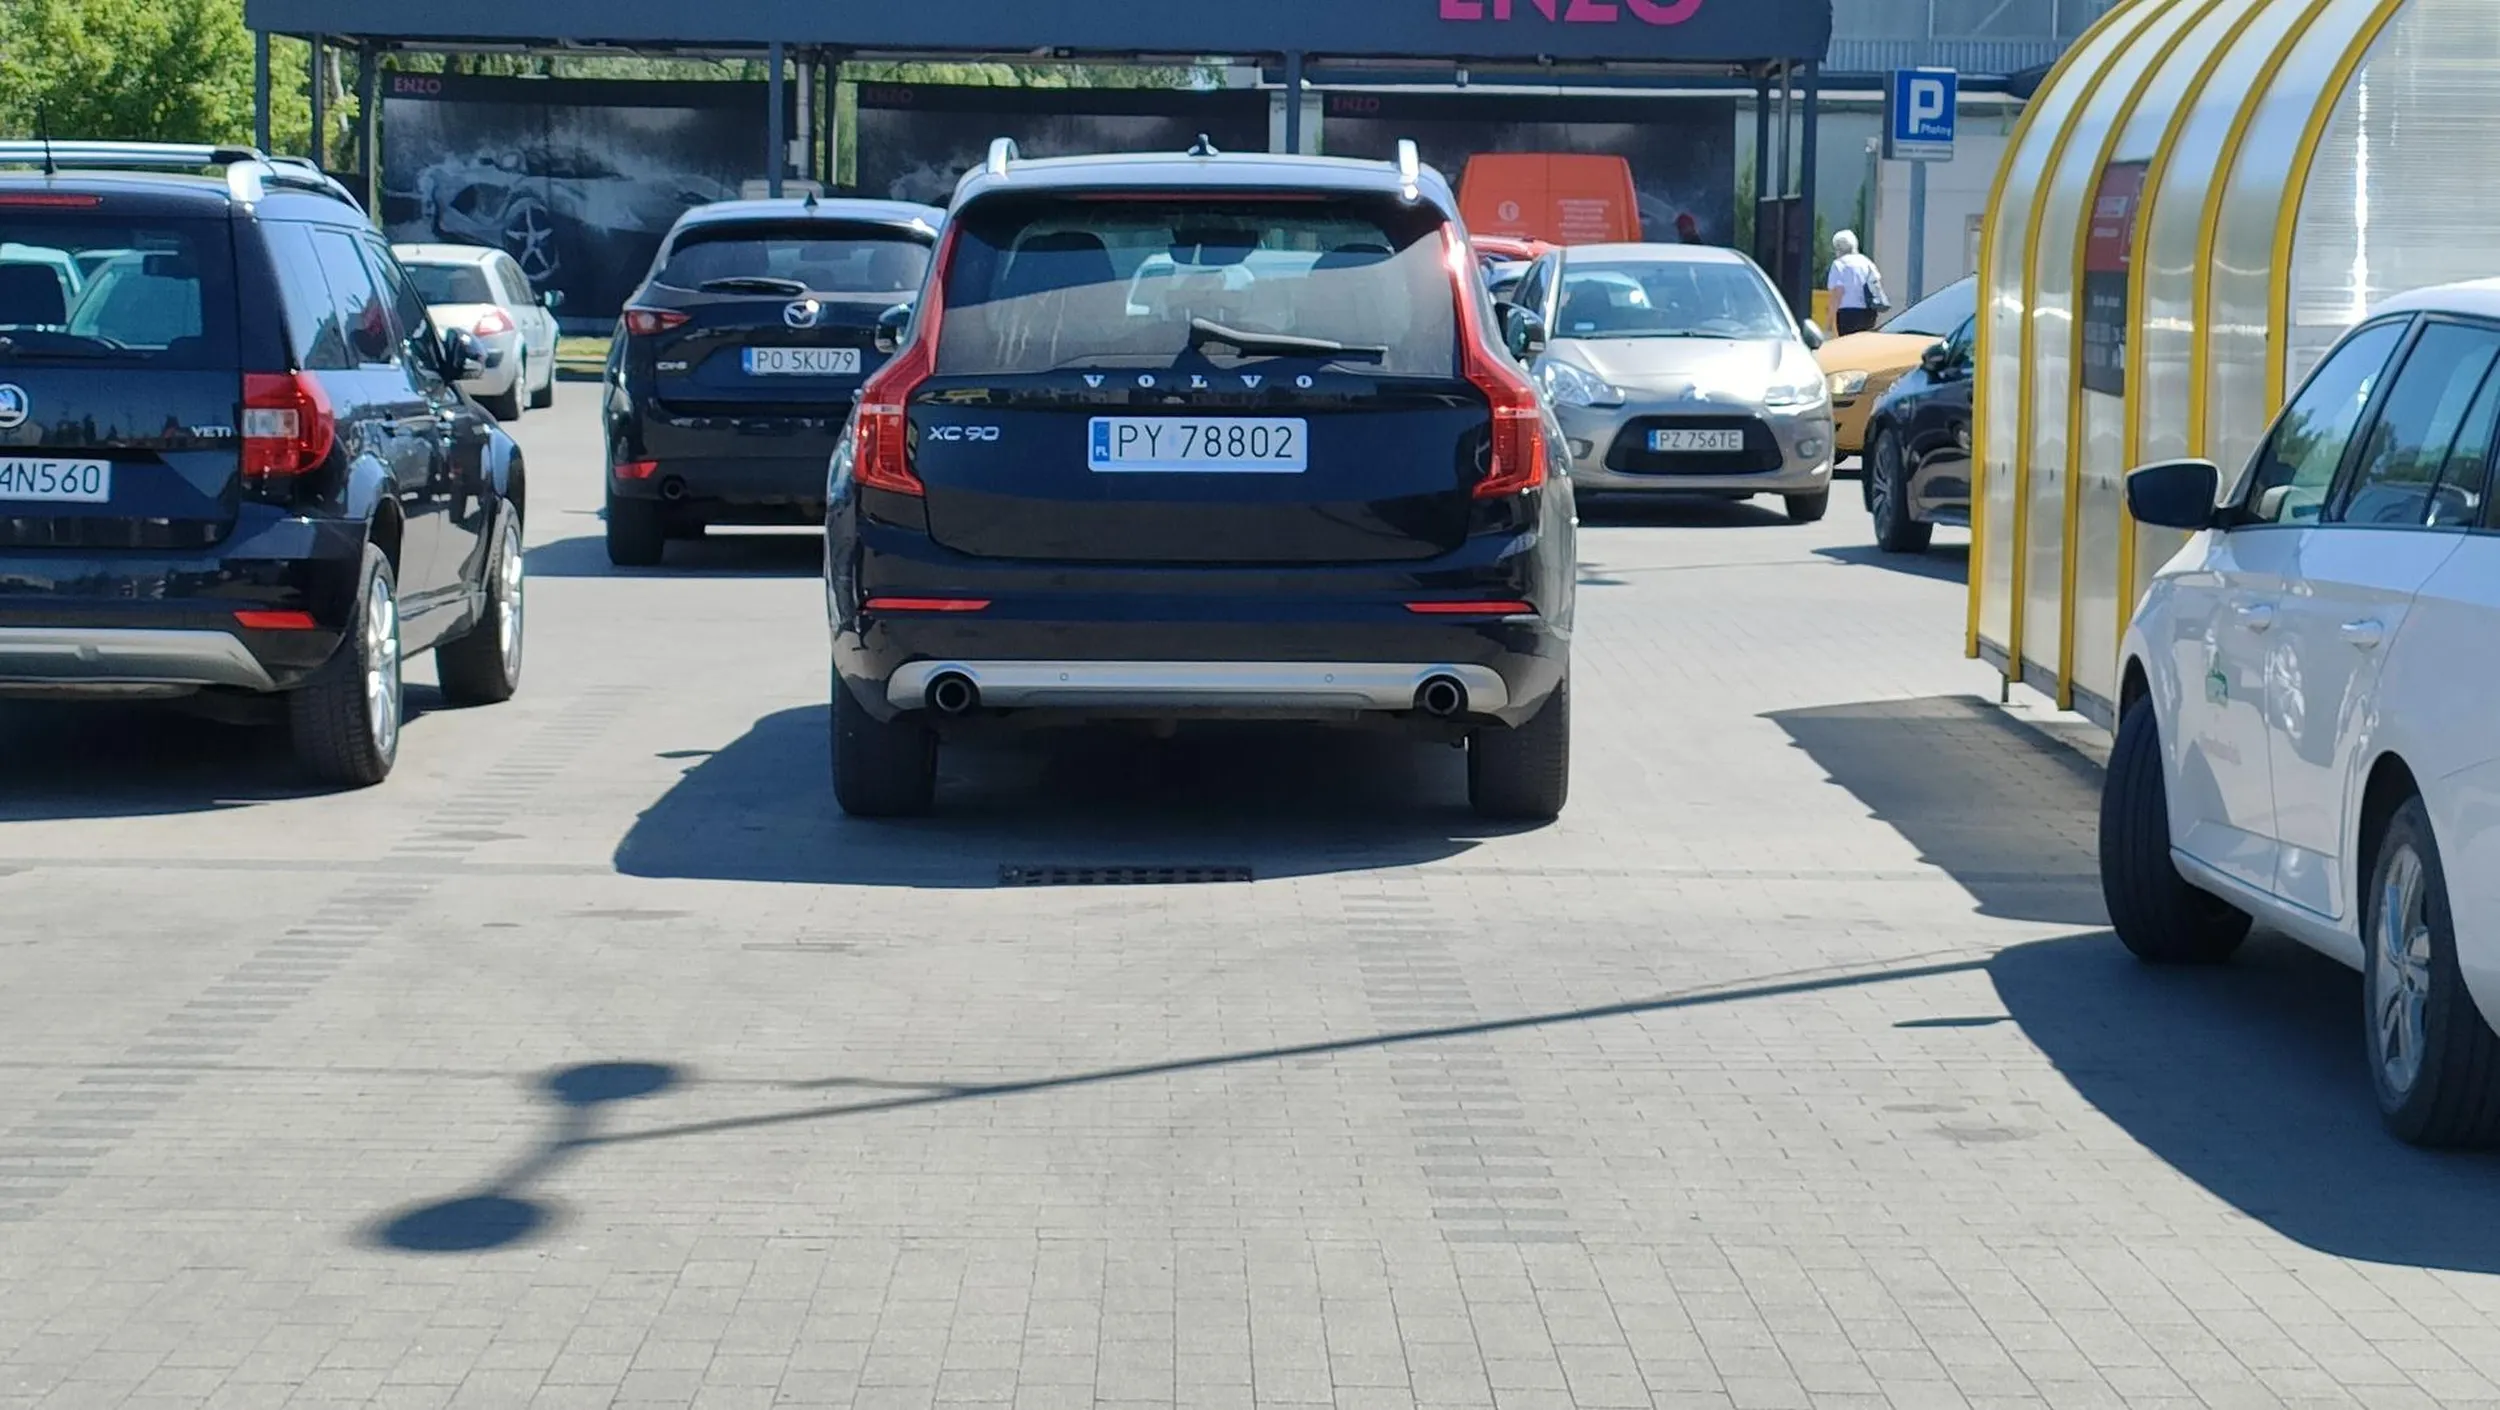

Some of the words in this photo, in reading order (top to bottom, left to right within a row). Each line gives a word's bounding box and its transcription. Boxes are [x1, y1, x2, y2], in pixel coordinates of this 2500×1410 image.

[394, 76, 442, 94] ENZO
[1909, 78, 1945, 135] P
[791, 350, 855, 370] 5KU79
[1083, 374, 1313, 389] VOLVO
[191, 425, 232, 438] YETI
[1660, 431, 1681, 448] PZ
[1687, 431, 1738, 448] 756TE
[1118, 425, 1163, 458] PY
[1180, 425, 1293, 458] 78802
